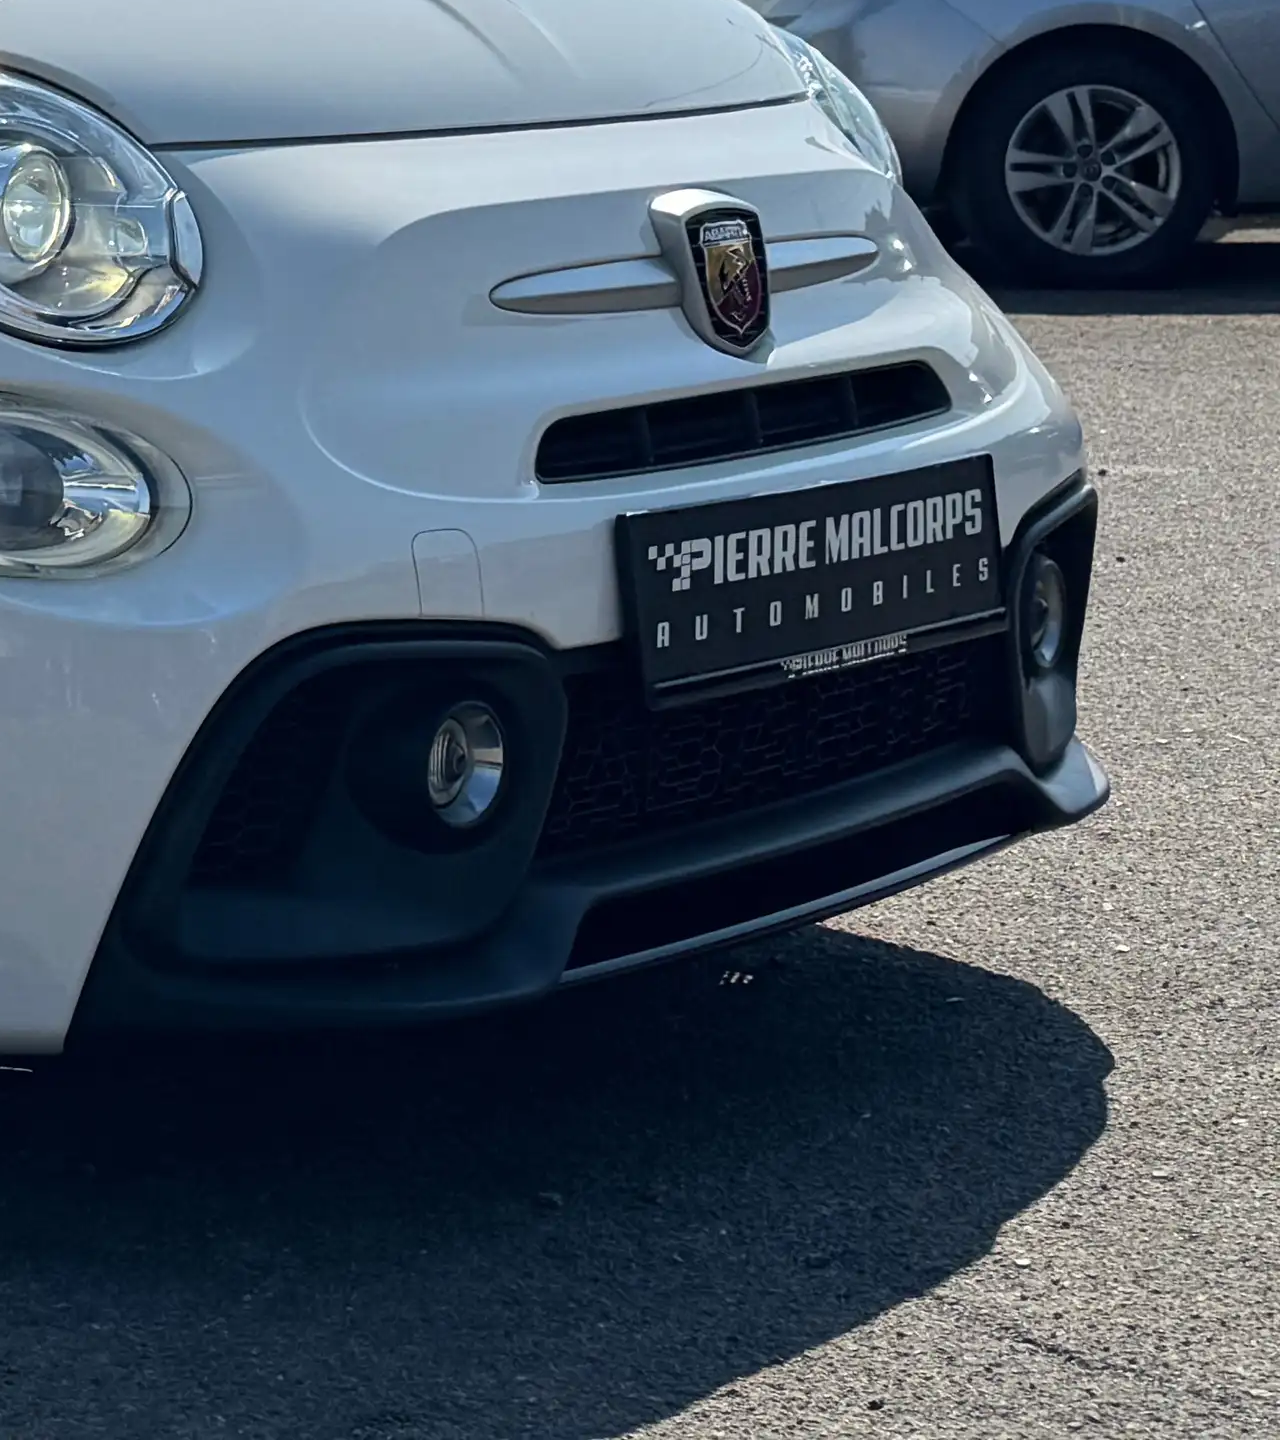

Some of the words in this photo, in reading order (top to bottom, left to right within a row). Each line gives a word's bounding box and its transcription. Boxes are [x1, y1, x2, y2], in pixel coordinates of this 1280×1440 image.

[672, 520, 817, 591] PIERRE
[825, 488, 983, 564] MALCORPS
[656, 557, 989, 648] AUTOMOBILES
